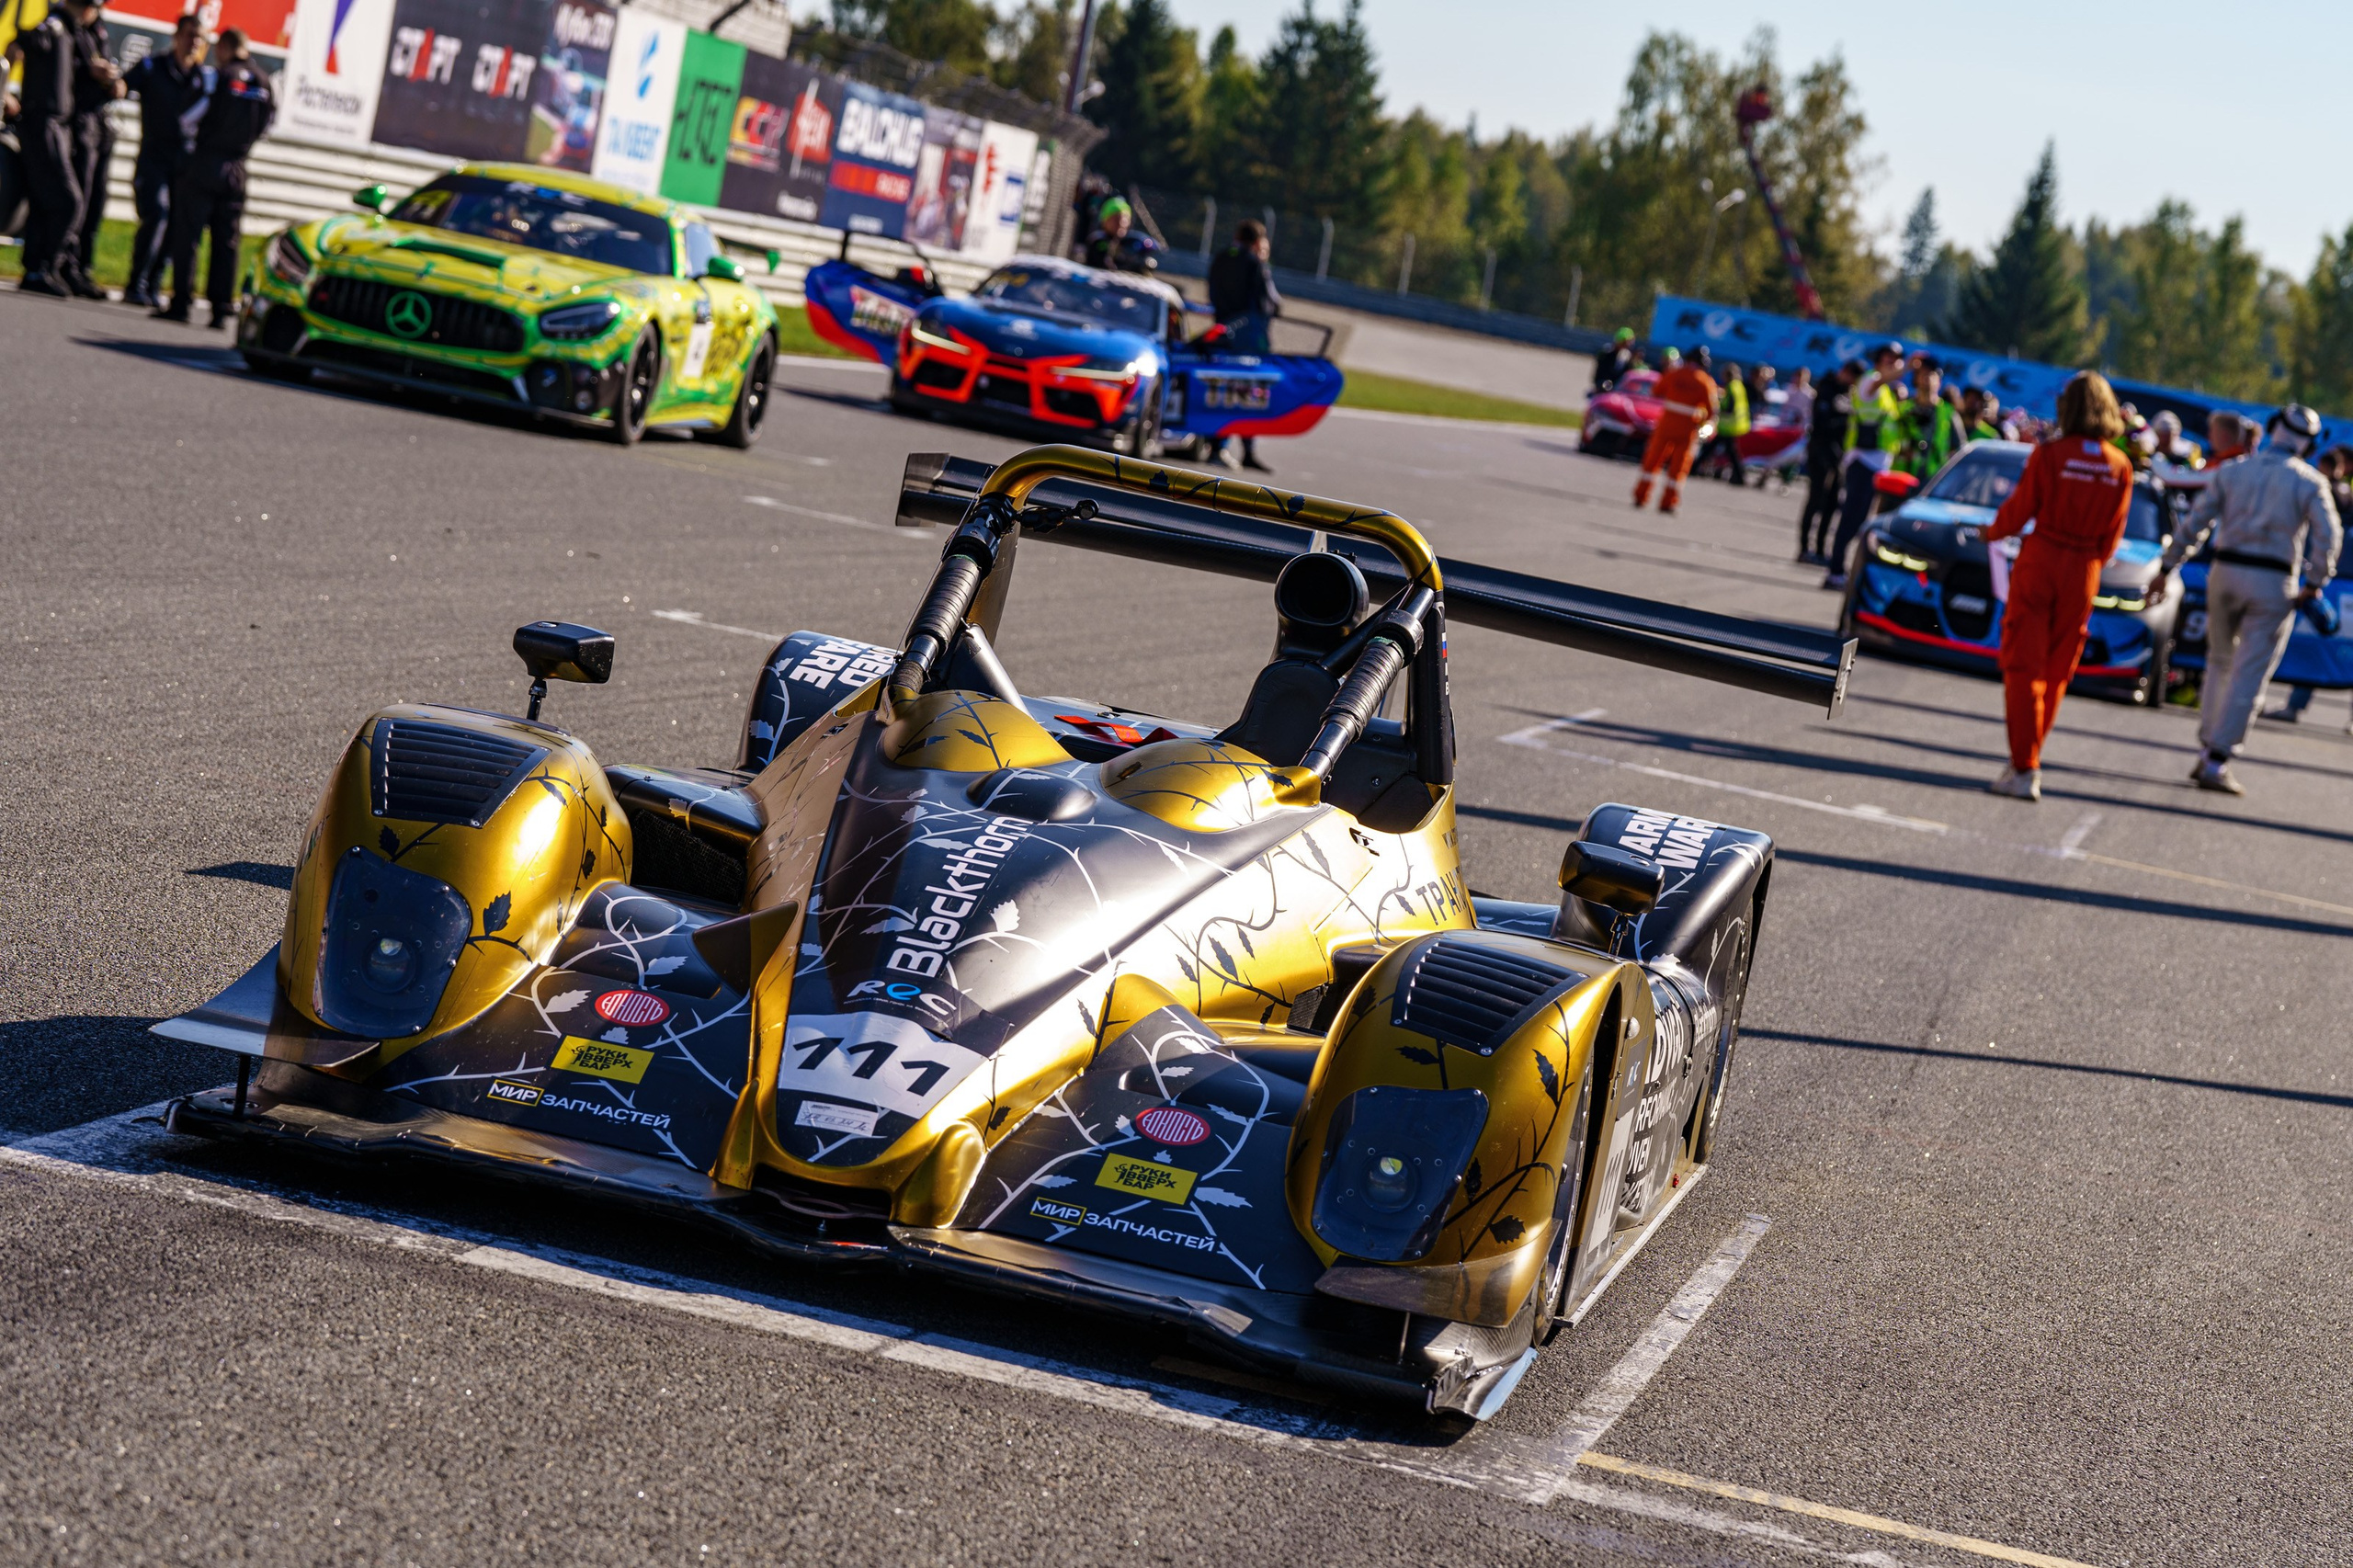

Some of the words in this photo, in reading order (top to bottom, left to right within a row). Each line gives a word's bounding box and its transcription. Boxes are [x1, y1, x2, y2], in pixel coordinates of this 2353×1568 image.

[1654, 815, 1721, 869] WAR
[886, 816, 1034, 978] Blackthorn
[601, 993, 664, 1023] ЮНОСТЬ
[579, 1061, 610, 1071] БАР
[586, 1045, 628, 1060] РУКИ
[793, 1037, 950, 1097] 111
[489, 1083, 539, 1101] МИР
[540, 1094, 672, 1129] ЗАПЧАСТЕЙ
[1142, 1110, 1204, 1142] ЮНОСТЬ
[1122, 1179, 1154, 1190] БАР
[1130, 1164, 1171, 1179] РУКИ
[1031, 1200, 1081, 1220] МИР
[1084, 1212, 1215, 1253] ЗАПЧАСТЕЙ
